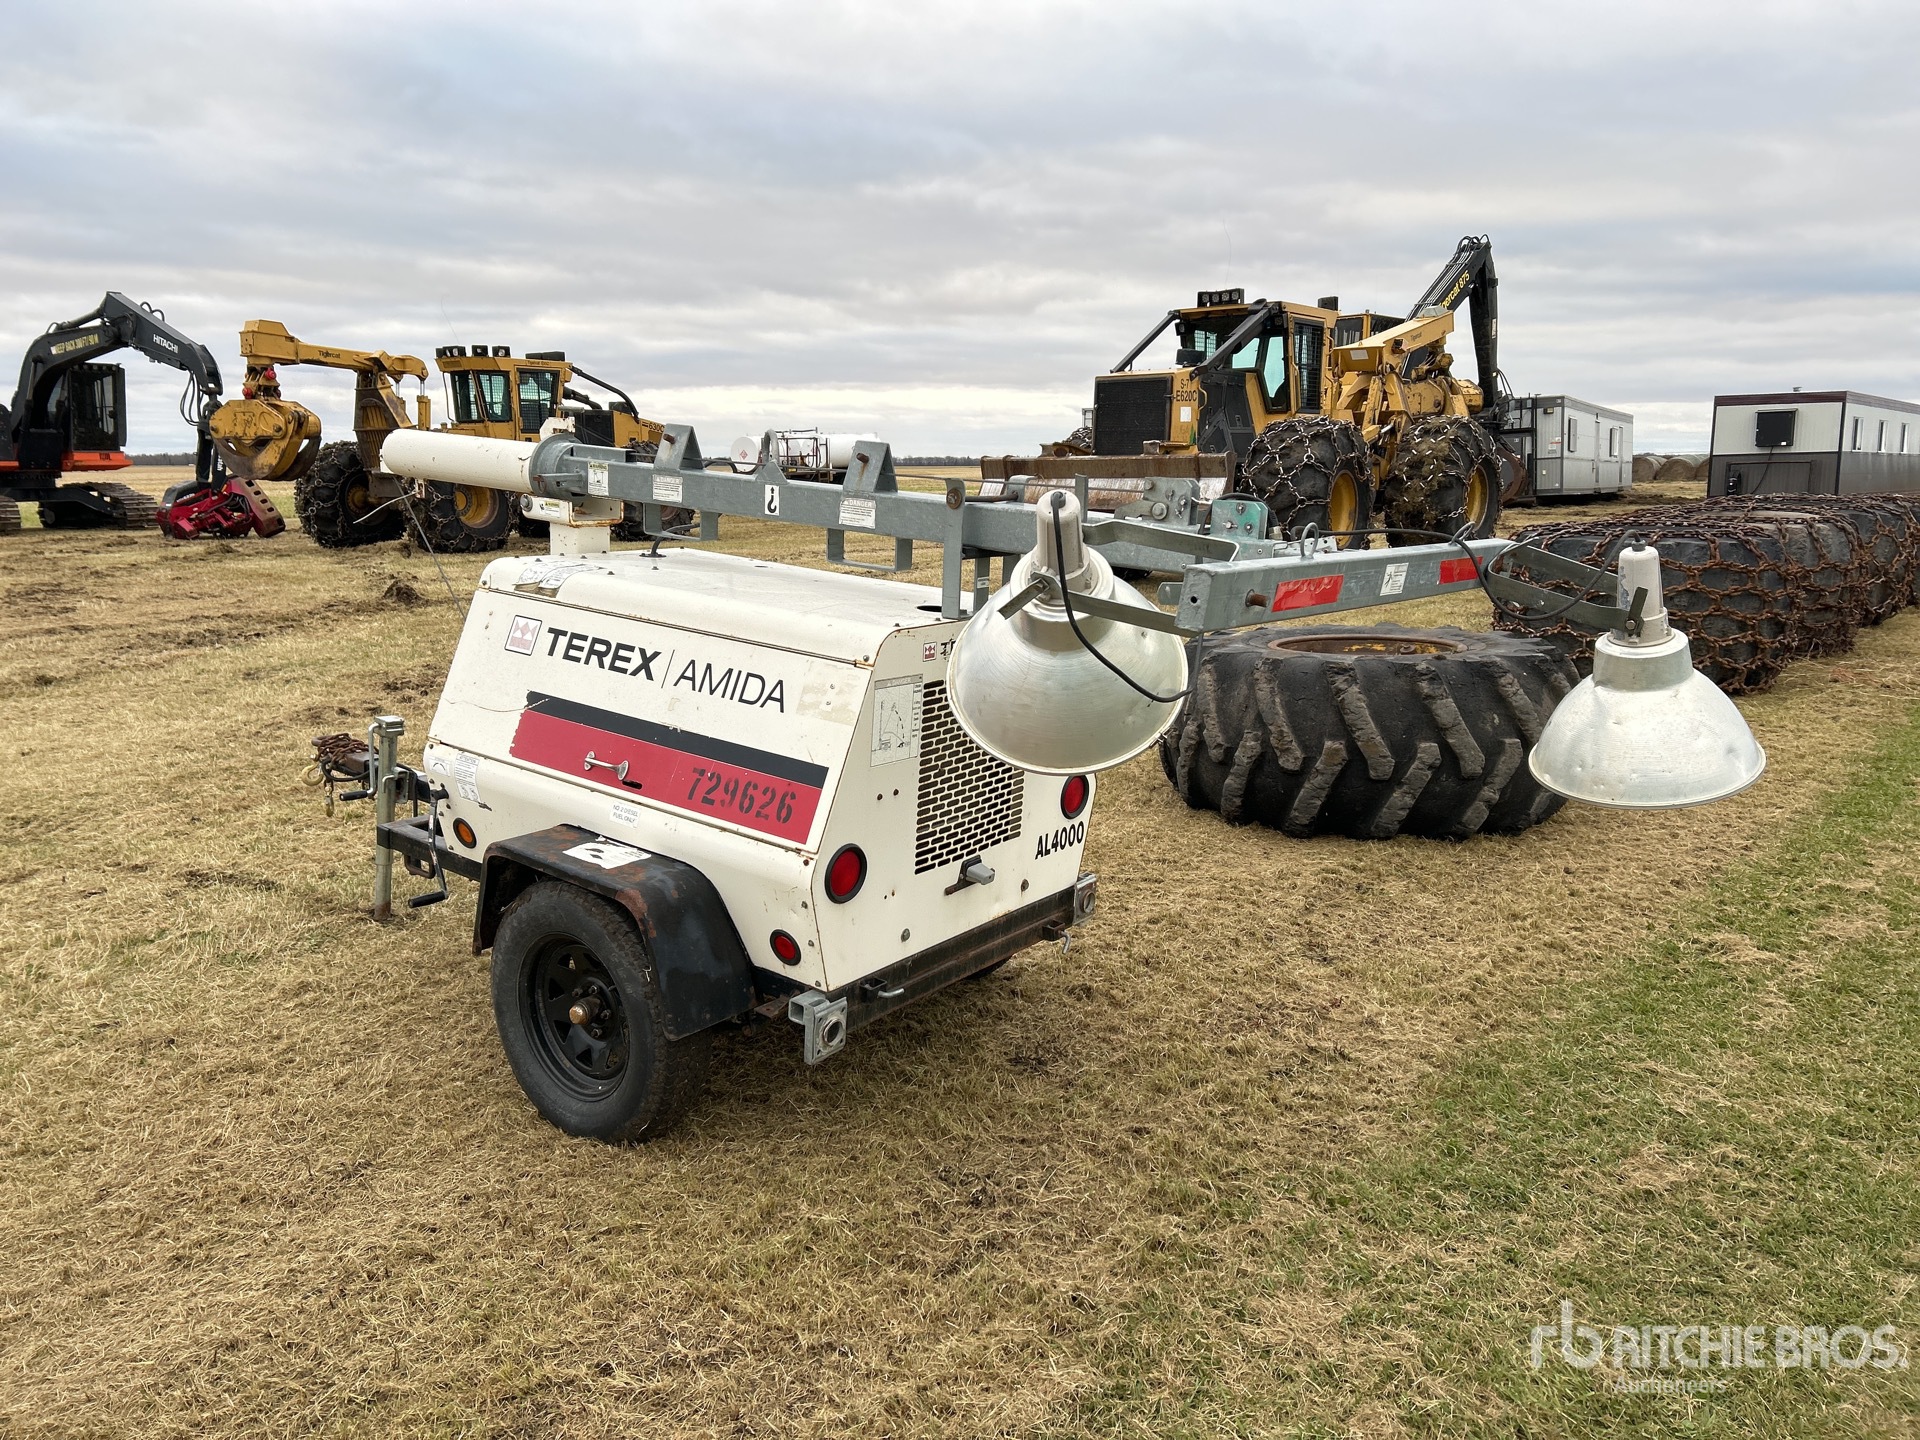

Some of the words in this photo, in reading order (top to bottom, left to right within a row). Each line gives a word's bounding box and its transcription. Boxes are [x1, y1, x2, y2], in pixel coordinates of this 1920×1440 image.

[1440, 281, 1461, 308] gercat
[1459, 270, 1470, 289] 875
[153, 334, 179, 354] HITACHI
[317, 349, 341, 359] Tigercat
[1180, 378, 1190, 389] S-7
[1175, 390, 1198, 402] E620C
[849, 499, 873, 508] DANGER
[547, 626, 662, 682] TEREX
[673, 659, 785, 714] AMIDA
[687, 767, 797, 824] 729626
[1035, 820, 1085, 860] AL4000
